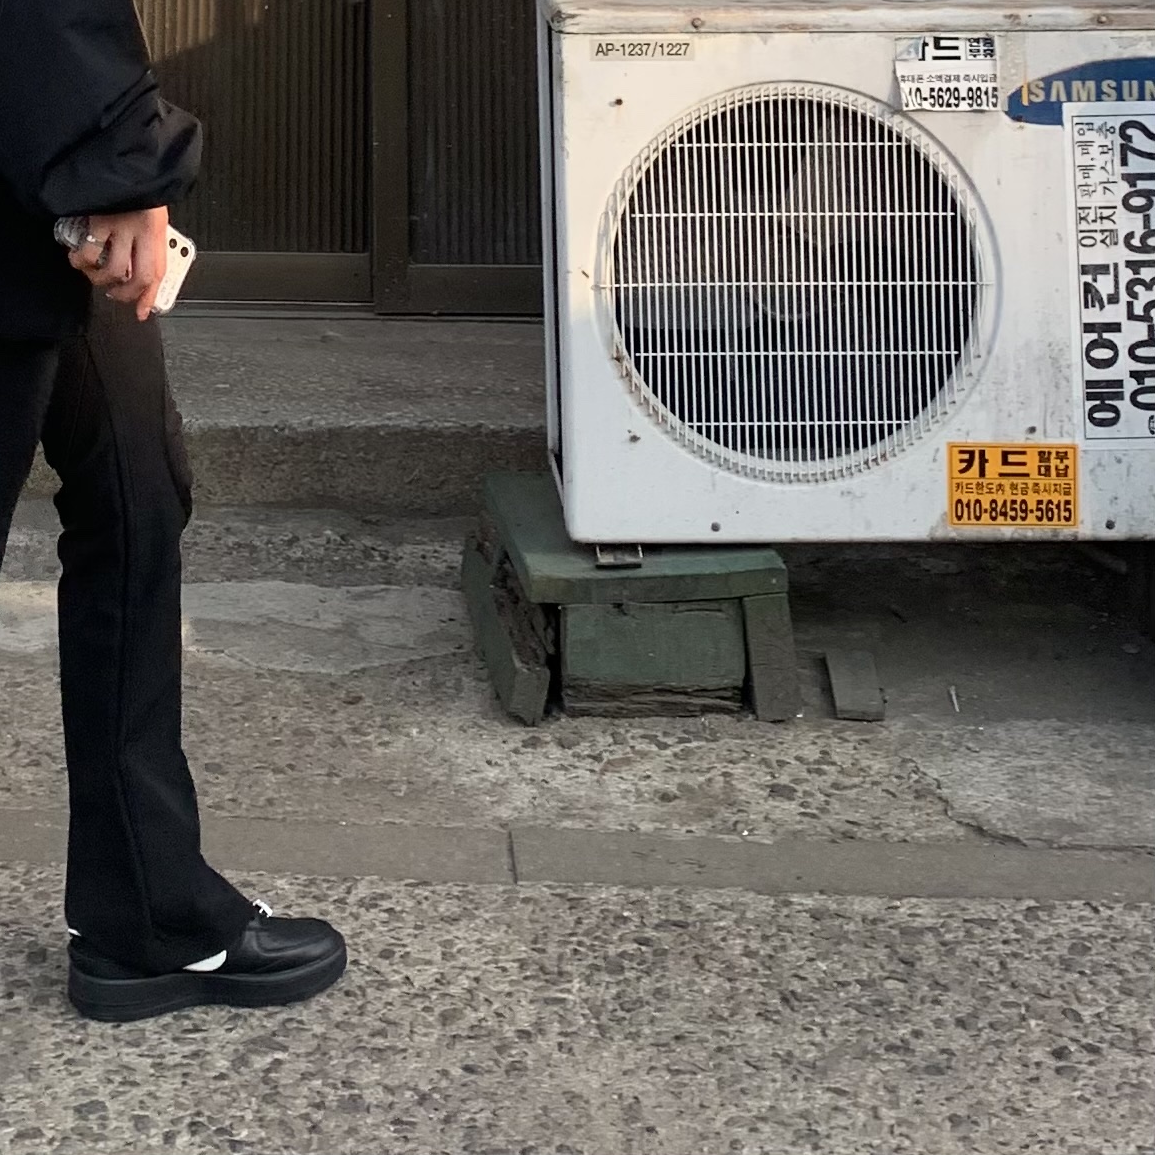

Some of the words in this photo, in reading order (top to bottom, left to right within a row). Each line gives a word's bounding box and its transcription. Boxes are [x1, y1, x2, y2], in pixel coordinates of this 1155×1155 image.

[595, 41, 690, 57] AP-1237/1227
[1096, 121, 1119, 196] 가스보충
[1077, 205, 1099, 248] 이전
[1097, 205, 1119, 249] 설치
[1080, 262, 1127, 428] 에어컨
[957, 449, 1031, 478] 카드
[954, 498, 1072, 523] 010-8459-5615
